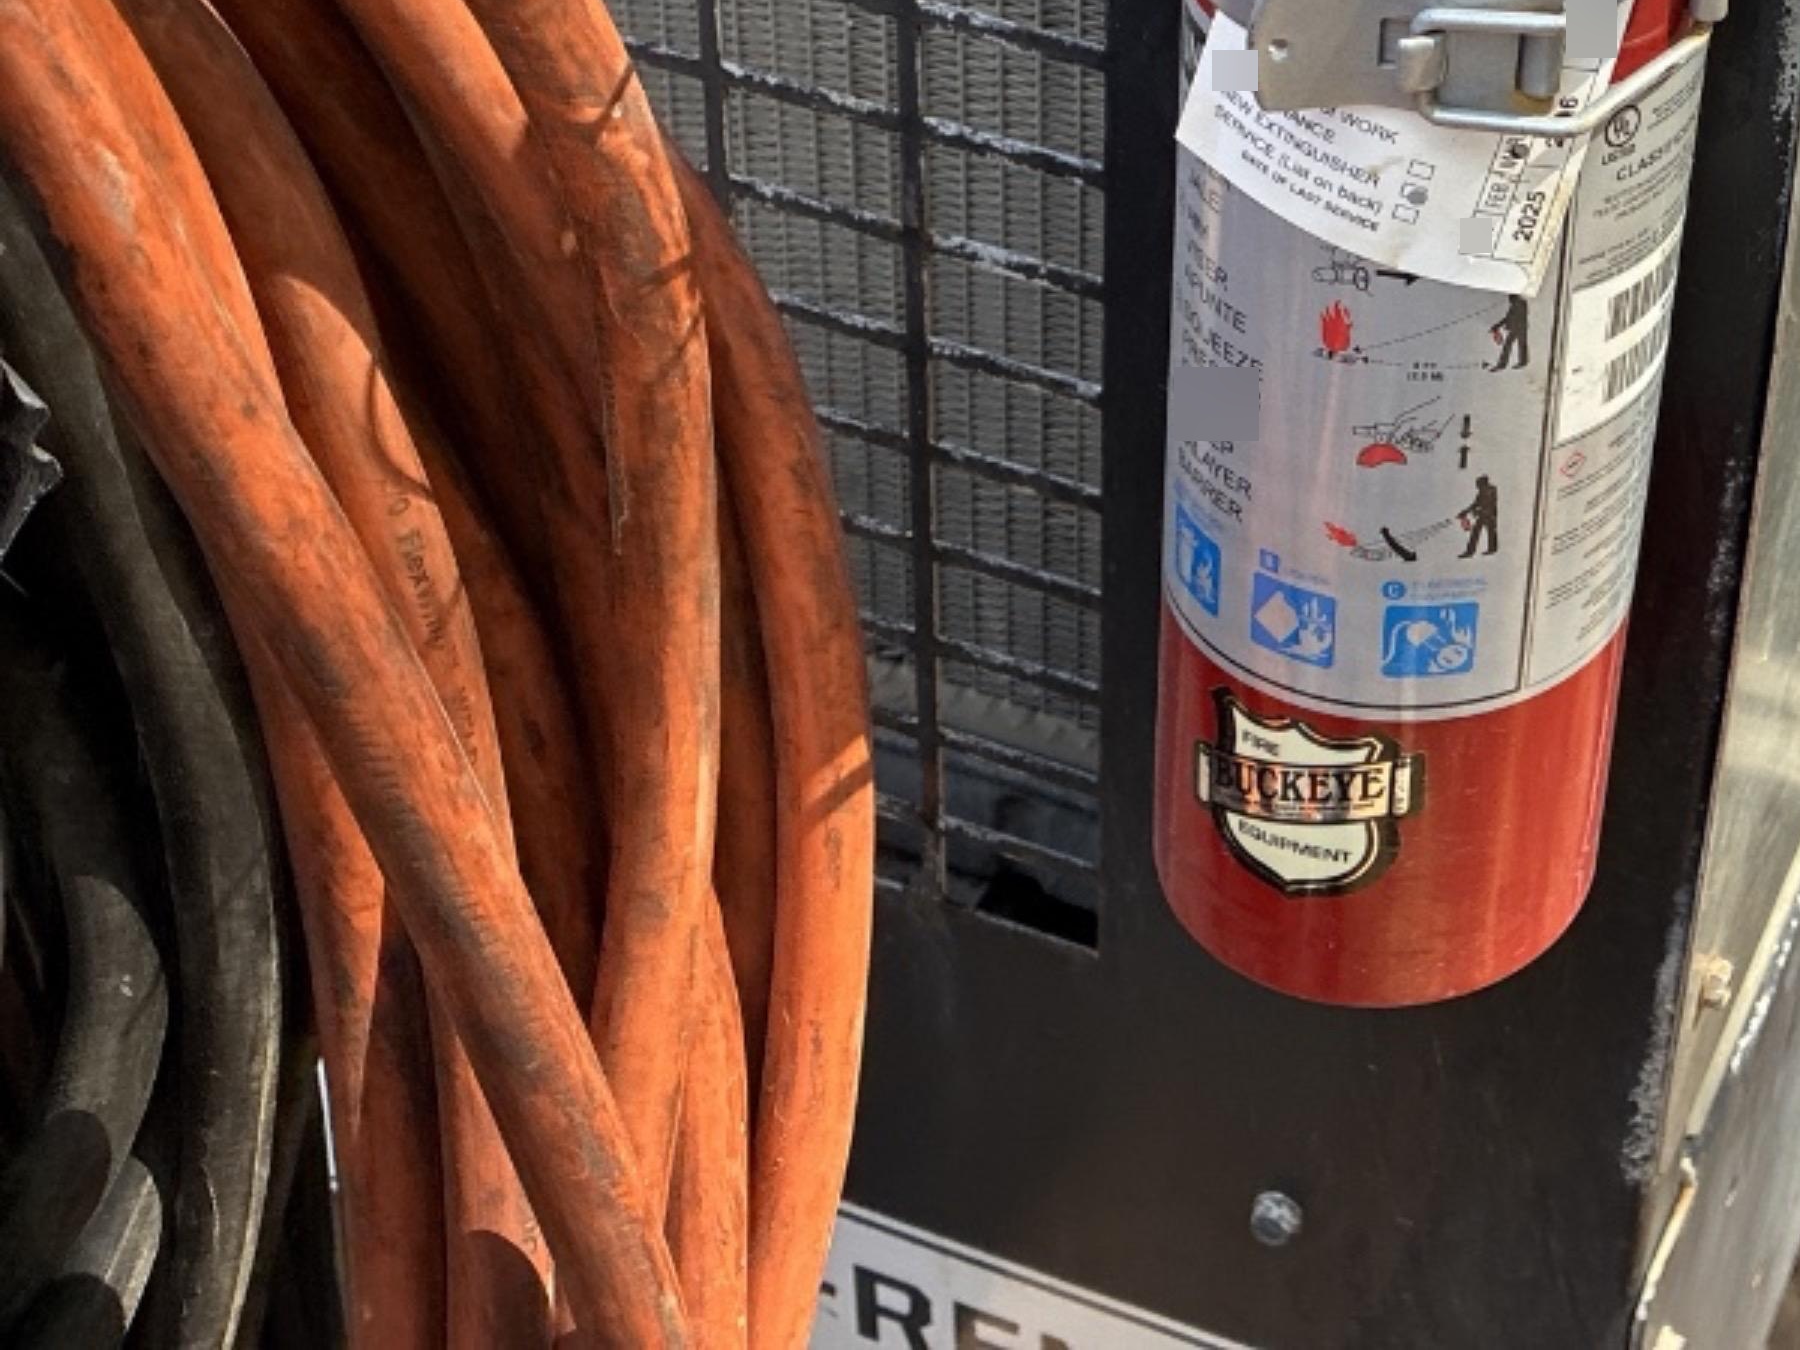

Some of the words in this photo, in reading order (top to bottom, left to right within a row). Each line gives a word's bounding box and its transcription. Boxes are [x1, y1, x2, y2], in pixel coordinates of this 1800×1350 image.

[1340, 112, 1400, 146] WORK
[1512, 191, 1547, 242] 2025
[1241, 730, 1281, 756] FIRE
[1214, 754, 1385, 803] BUCKEYE
[1237, 818, 1353, 864] EQUIPMENT
